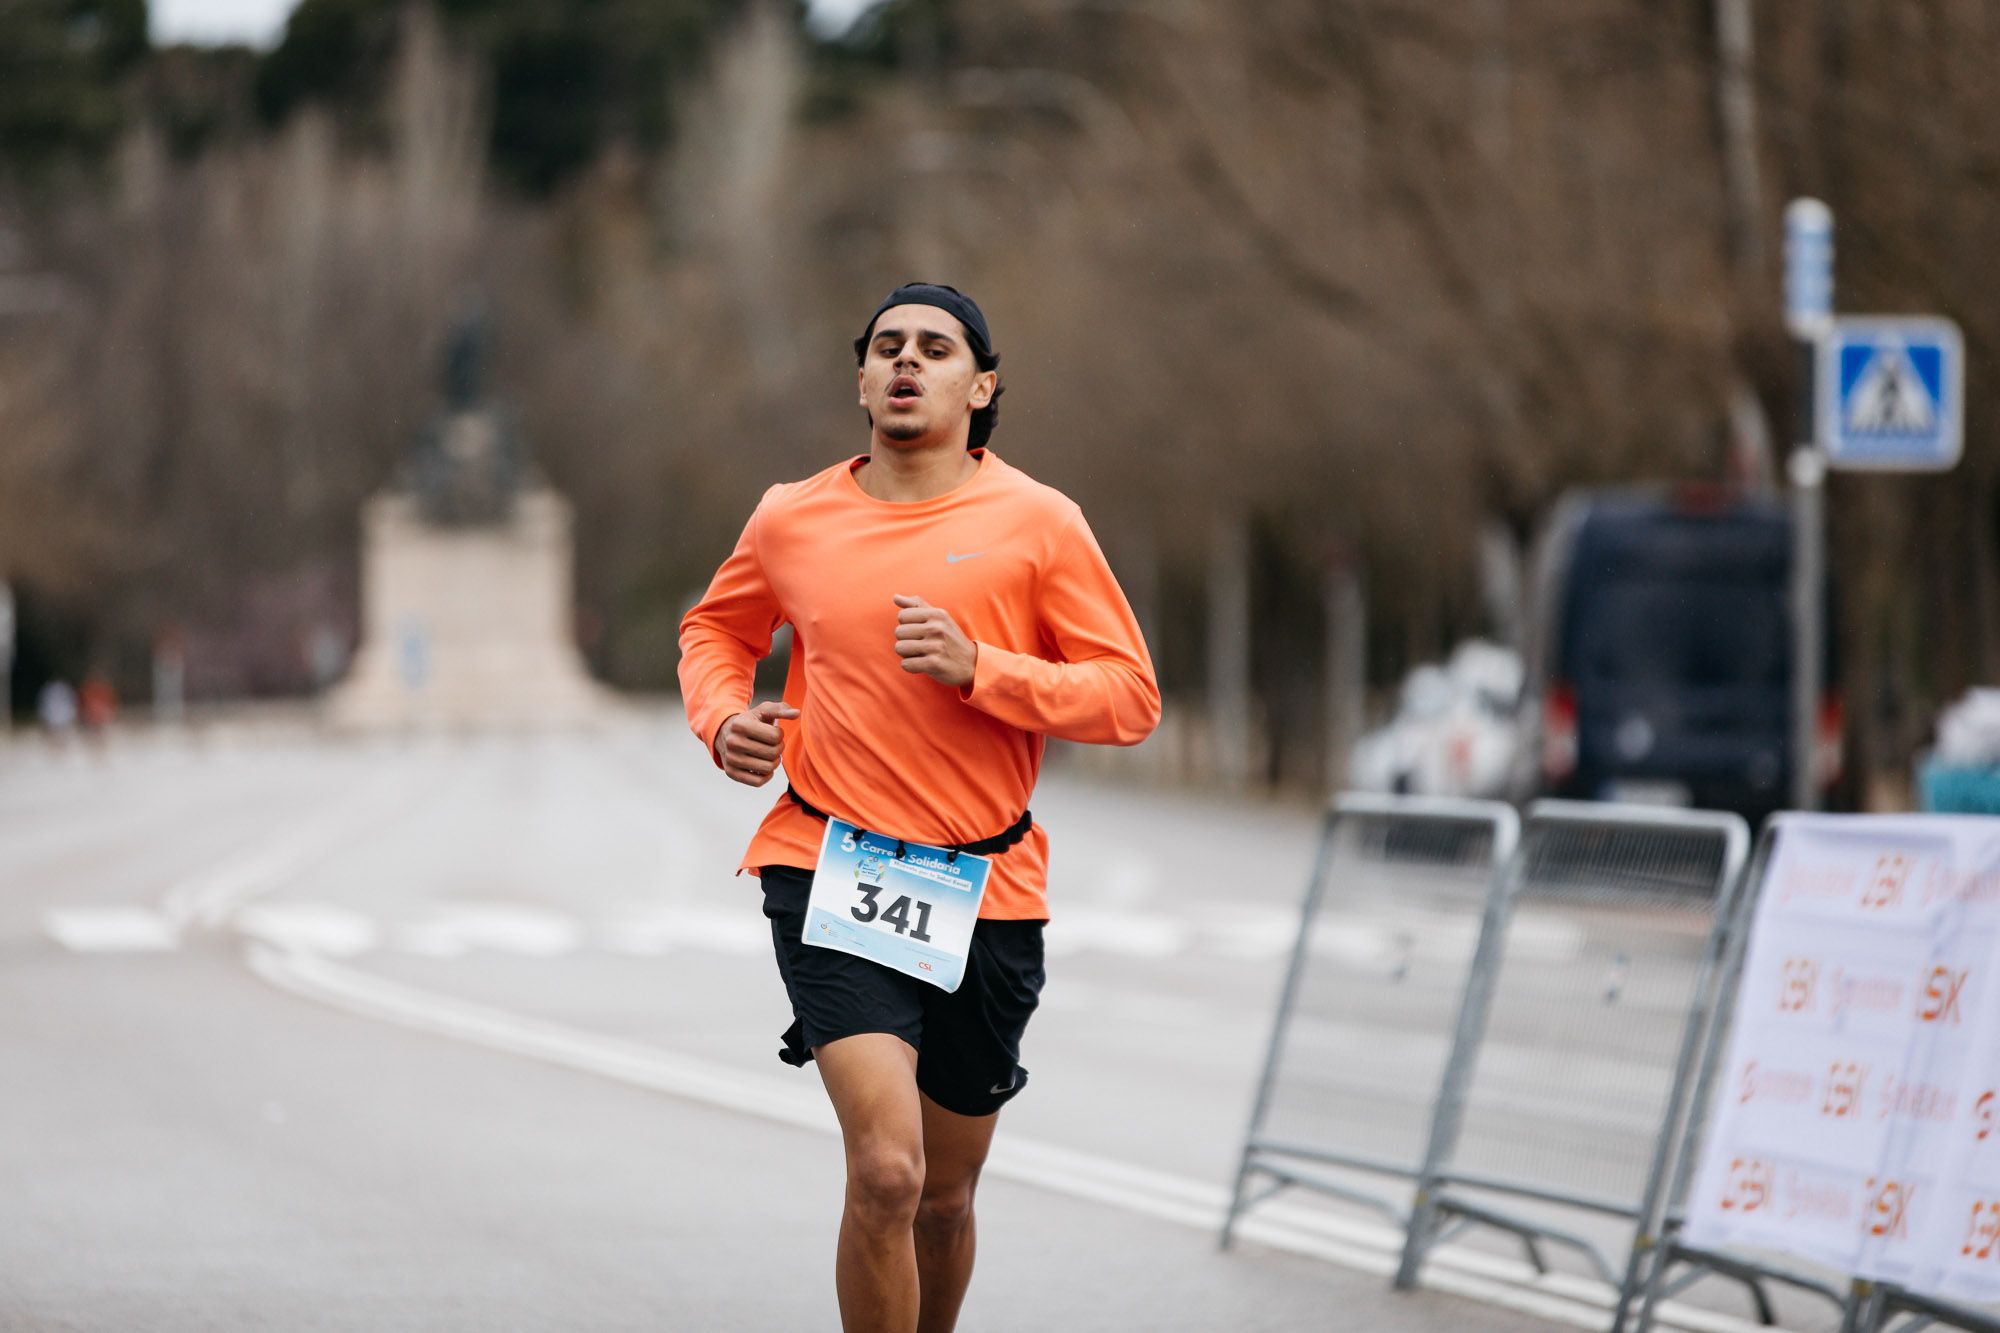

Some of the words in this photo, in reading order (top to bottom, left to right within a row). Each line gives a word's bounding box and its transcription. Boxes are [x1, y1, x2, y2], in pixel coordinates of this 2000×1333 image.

[908, 854, 961, 876] Solidaria
[850, 882, 933, 943] 341
[918, 961, 934, 972] CSL
